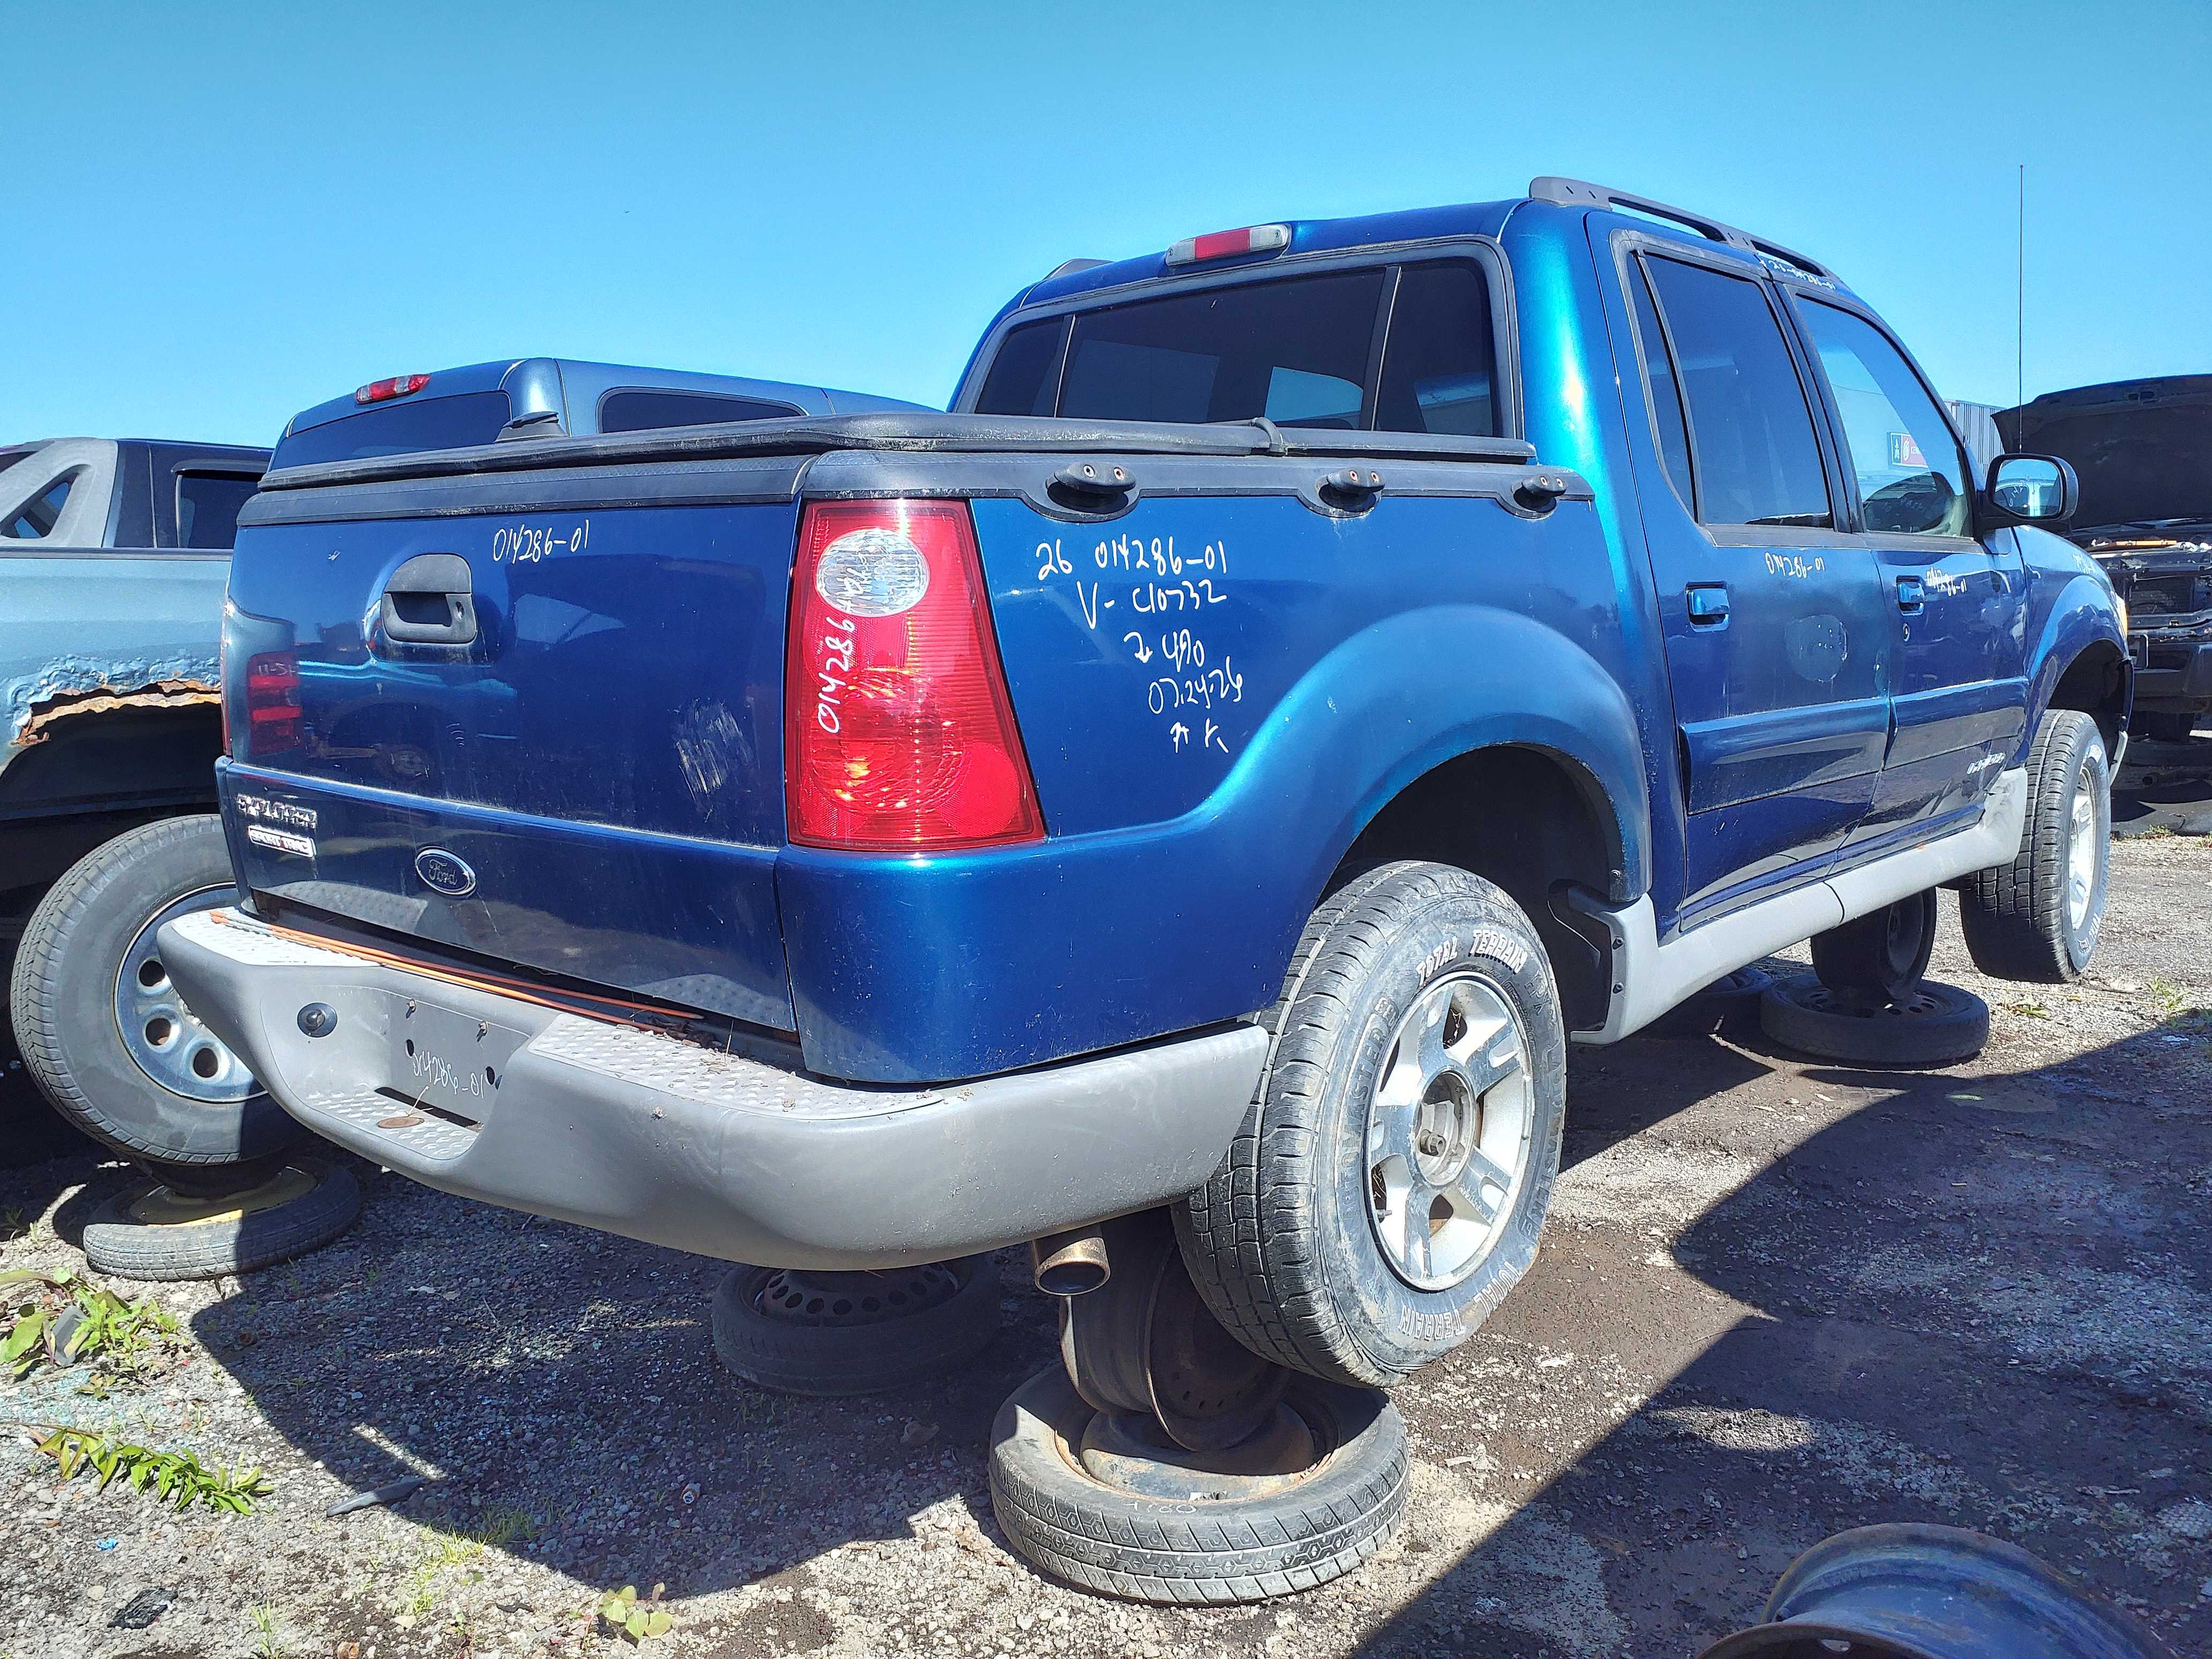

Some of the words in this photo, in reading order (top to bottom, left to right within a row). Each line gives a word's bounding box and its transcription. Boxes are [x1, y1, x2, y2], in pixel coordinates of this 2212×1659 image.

[493, 519, 589, 564] 014286-01
[1036, 538, 1073, 580] 26
[1095, 533, 1227, 576] 014286-01
[1765, 552, 1826, 579] 014286-01
[429, 859, 459, 885] Ford
[1416, 936, 1458, 987] TOTAL
[1469, 929, 1528, 974] TERRAIN
[412, 1050, 484, 1098] 014286-01
[1474, 1261, 1523, 1318] TOTAL
[1398, 1304, 1466, 1341] TERRAIN
